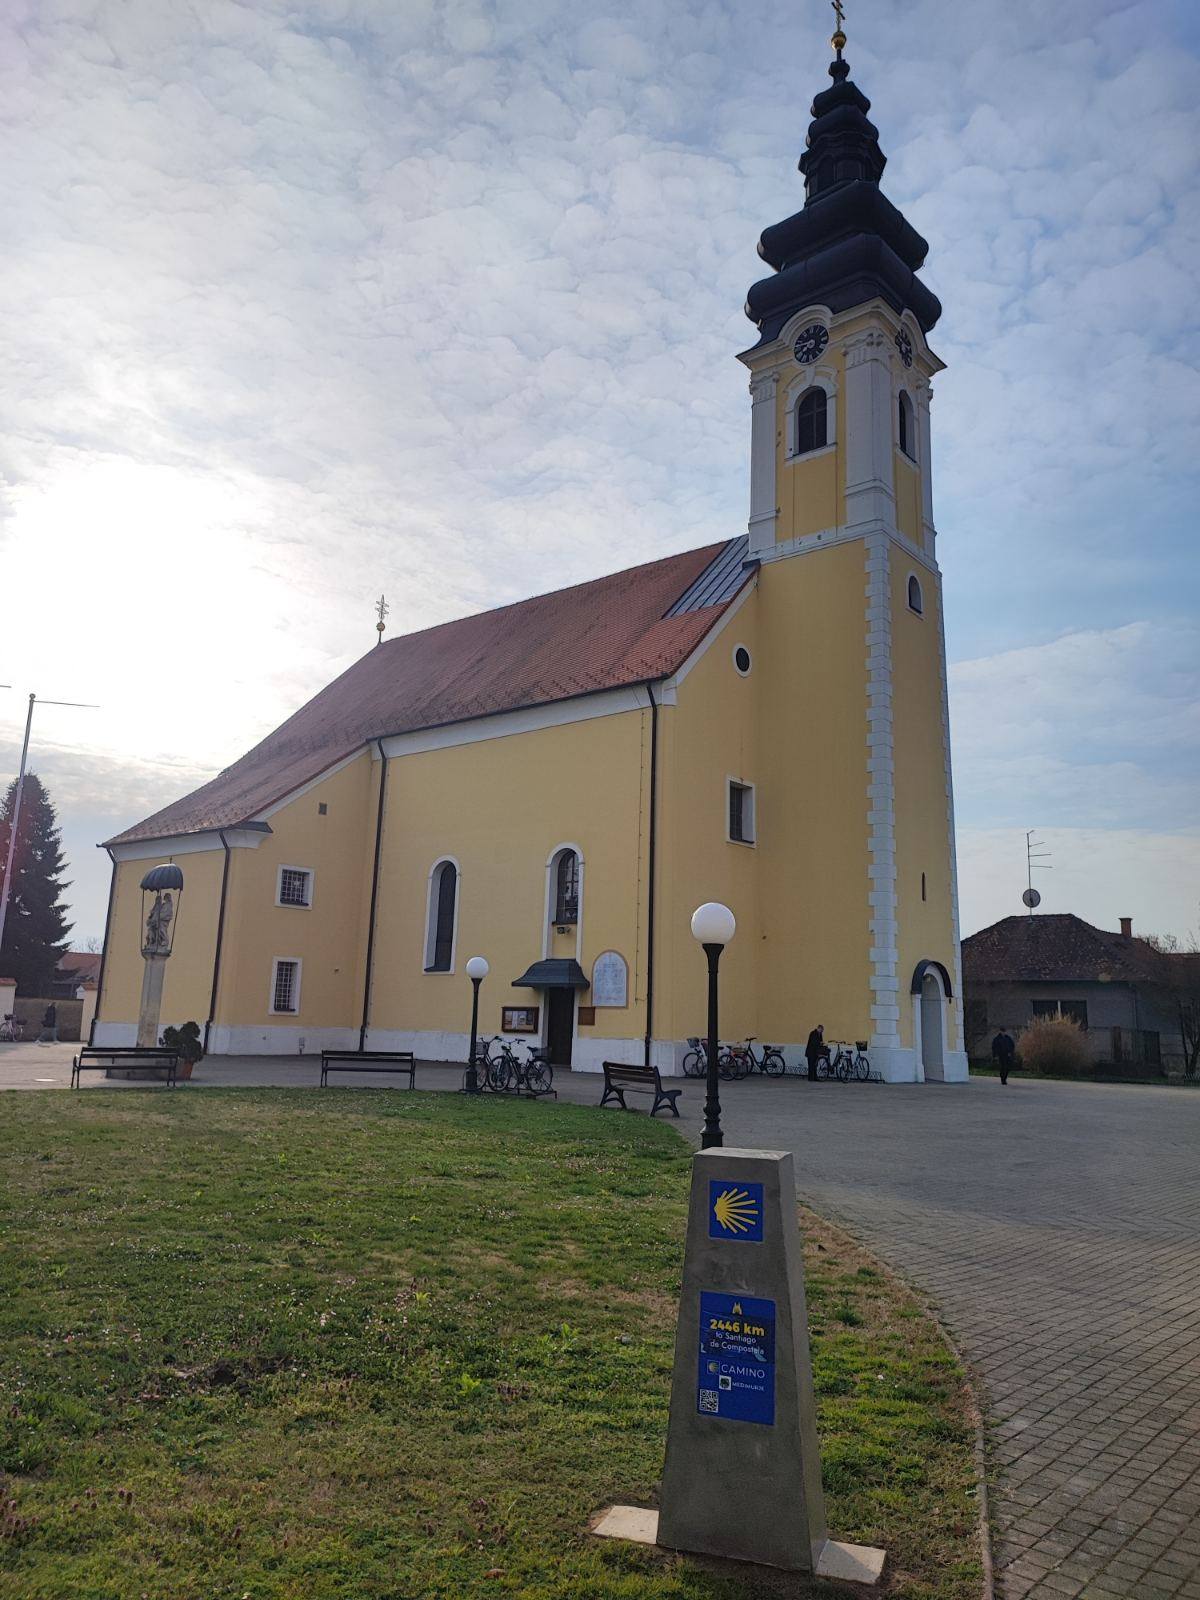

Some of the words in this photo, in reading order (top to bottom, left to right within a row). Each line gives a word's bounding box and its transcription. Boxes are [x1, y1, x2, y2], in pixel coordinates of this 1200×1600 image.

[710, 1319, 740, 1332] 2446
[743, 1323, 765, 1336] km
[725, 1332, 756, 1344] Santiago
[721, 1341, 764, 1354] Compostela
[721, 1364, 765, 1378] CAMINO
